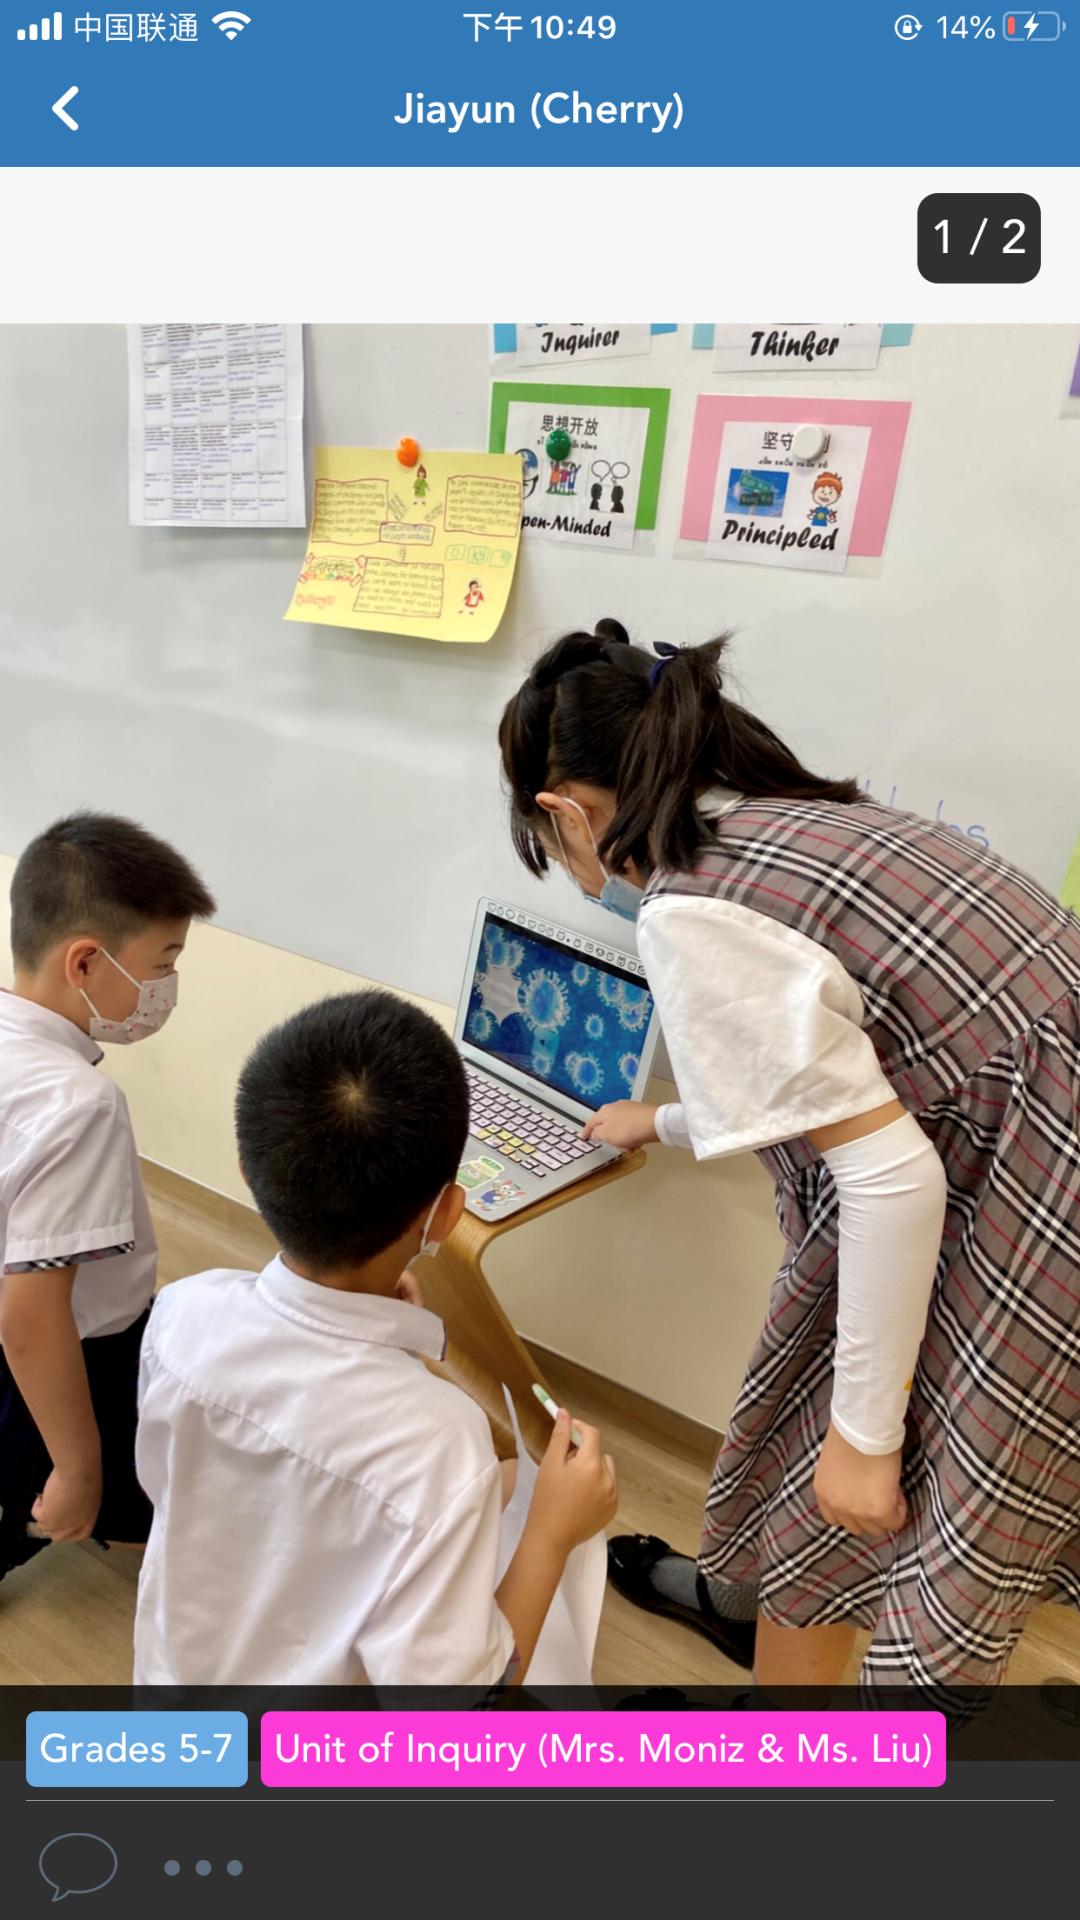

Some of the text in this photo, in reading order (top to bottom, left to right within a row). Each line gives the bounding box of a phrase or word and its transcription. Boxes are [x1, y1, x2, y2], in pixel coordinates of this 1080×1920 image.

[541, 327, 620, 356] Inquirer
[750, 330, 840, 362] Thinker
[541, 414, 599, 436] 思想开放
[520, 514, 612, 538] pen-Minded
[721, 519, 839, 551] Principled
